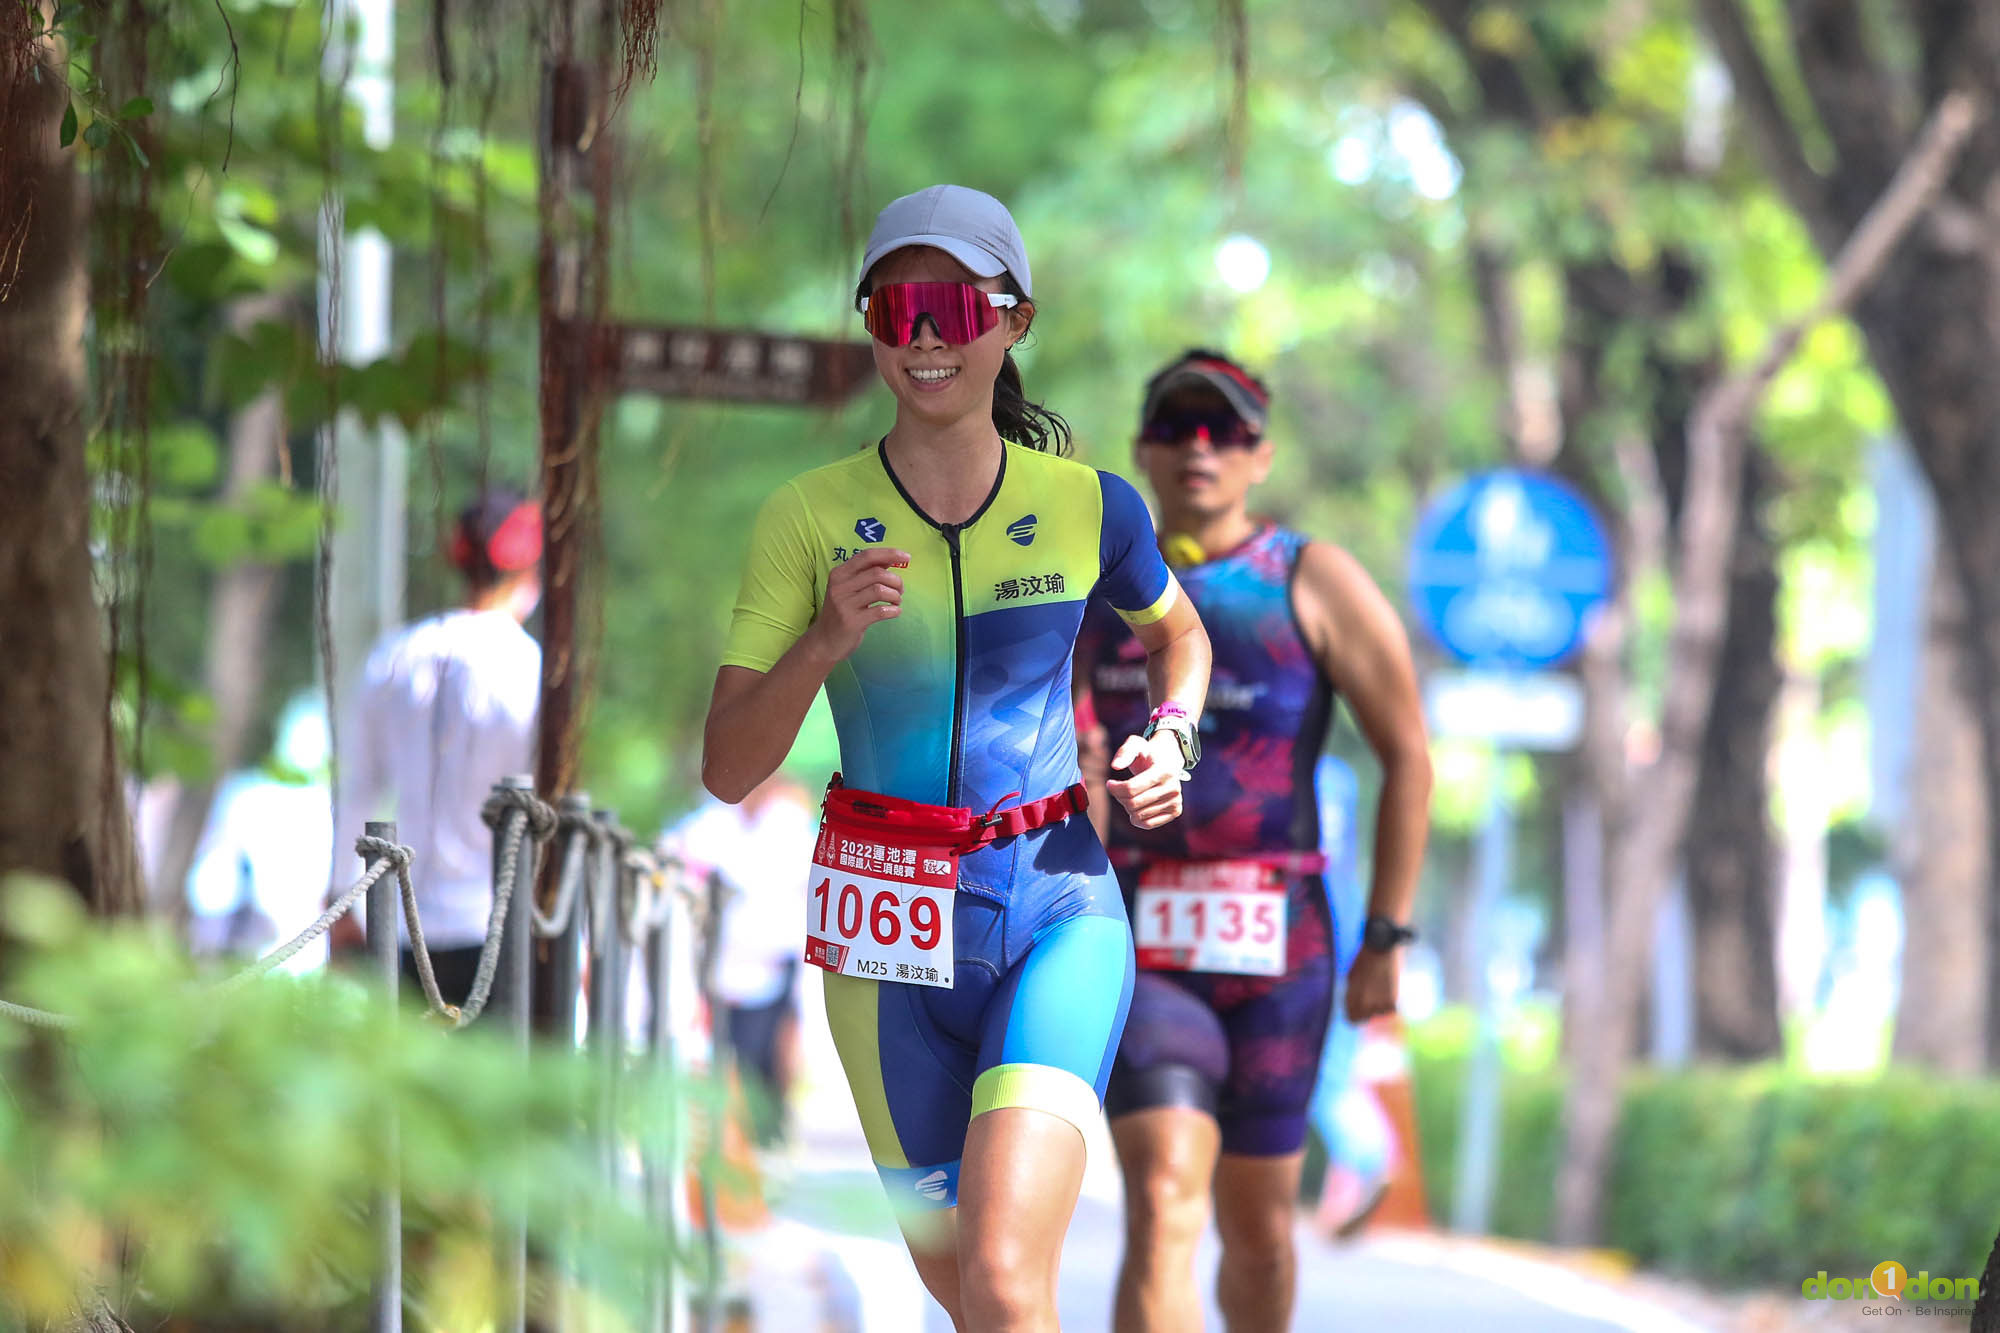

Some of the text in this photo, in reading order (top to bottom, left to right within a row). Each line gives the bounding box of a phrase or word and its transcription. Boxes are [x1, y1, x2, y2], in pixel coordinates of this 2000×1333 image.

[995, 573, 1065, 602] 湯汶瑜
[815, 877, 942, 950] 1069
[1153, 900, 1277, 944] 1135
[857, 960, 939, 983] M25 湯汶瑜
